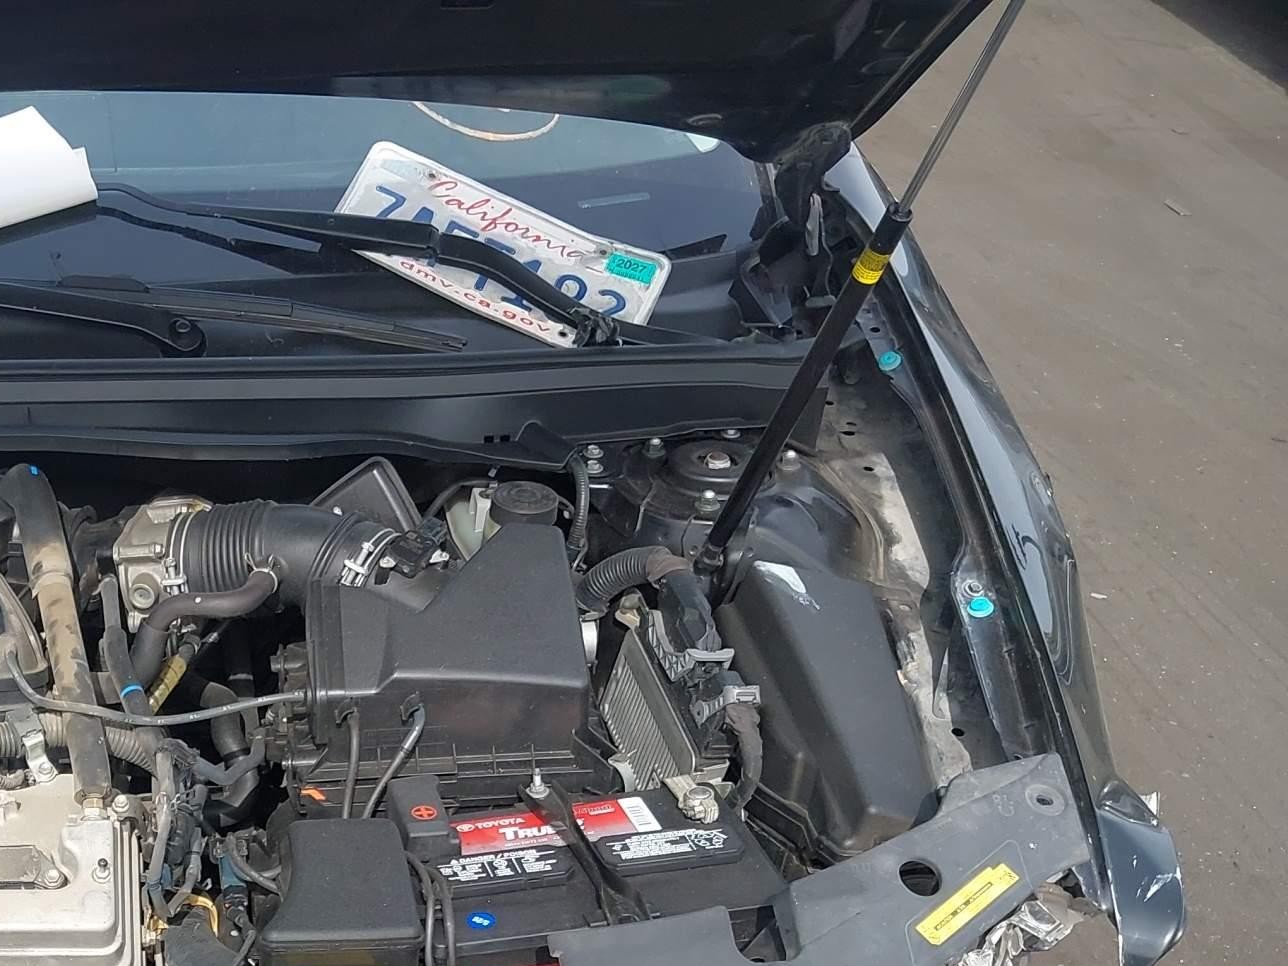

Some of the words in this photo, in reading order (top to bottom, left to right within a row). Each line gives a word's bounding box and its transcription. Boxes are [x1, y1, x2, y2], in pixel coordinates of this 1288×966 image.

[427, 180, 588, 260] California
[616, 258, 647, 273] 2027
[399, 260, 551, 332] dmv.ca.gov
[474, 817, 526, 829] TOYOTA
